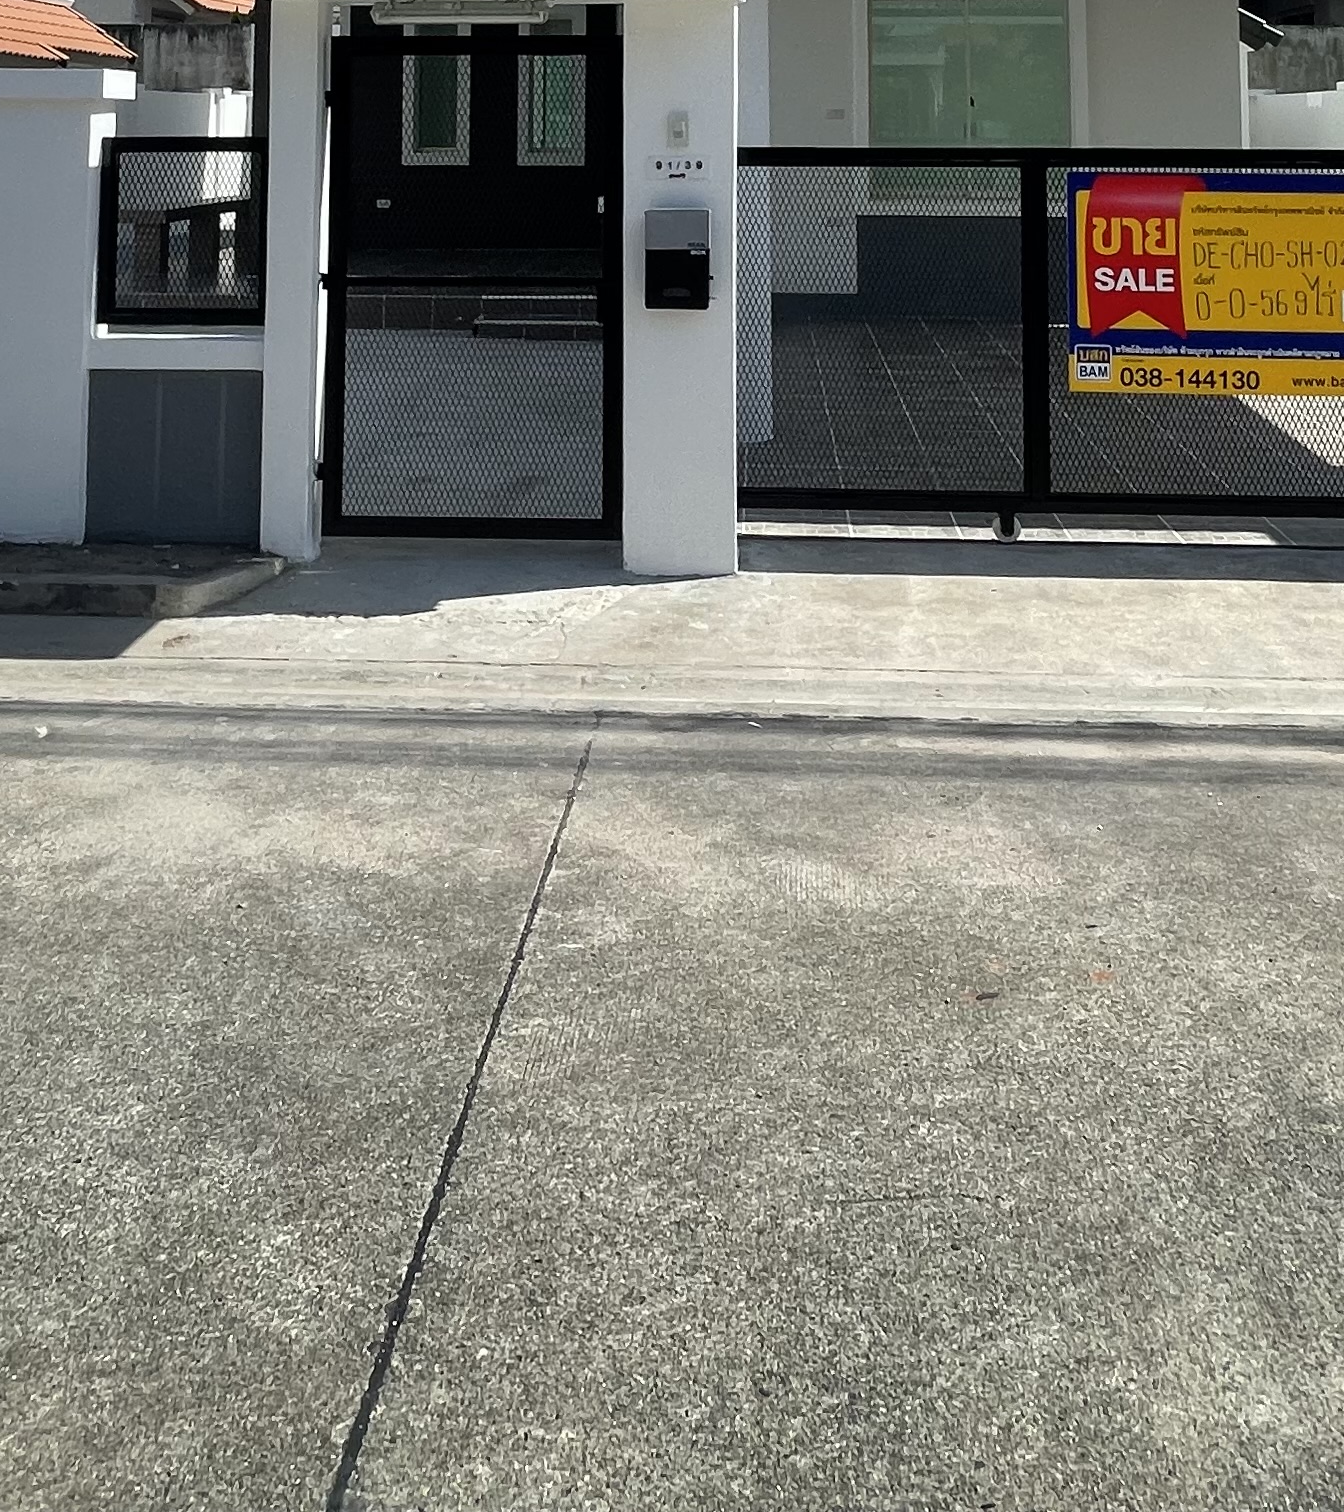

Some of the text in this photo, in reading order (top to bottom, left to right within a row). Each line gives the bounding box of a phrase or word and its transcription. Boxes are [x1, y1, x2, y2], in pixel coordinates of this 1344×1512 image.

[1092, 217, 1176, 256] ขาย
[1094, 267, 1175, 292] SALE
[1079, 365, 1108, 378] BAM
[1120, 367, 1260, 390] 038-144130
